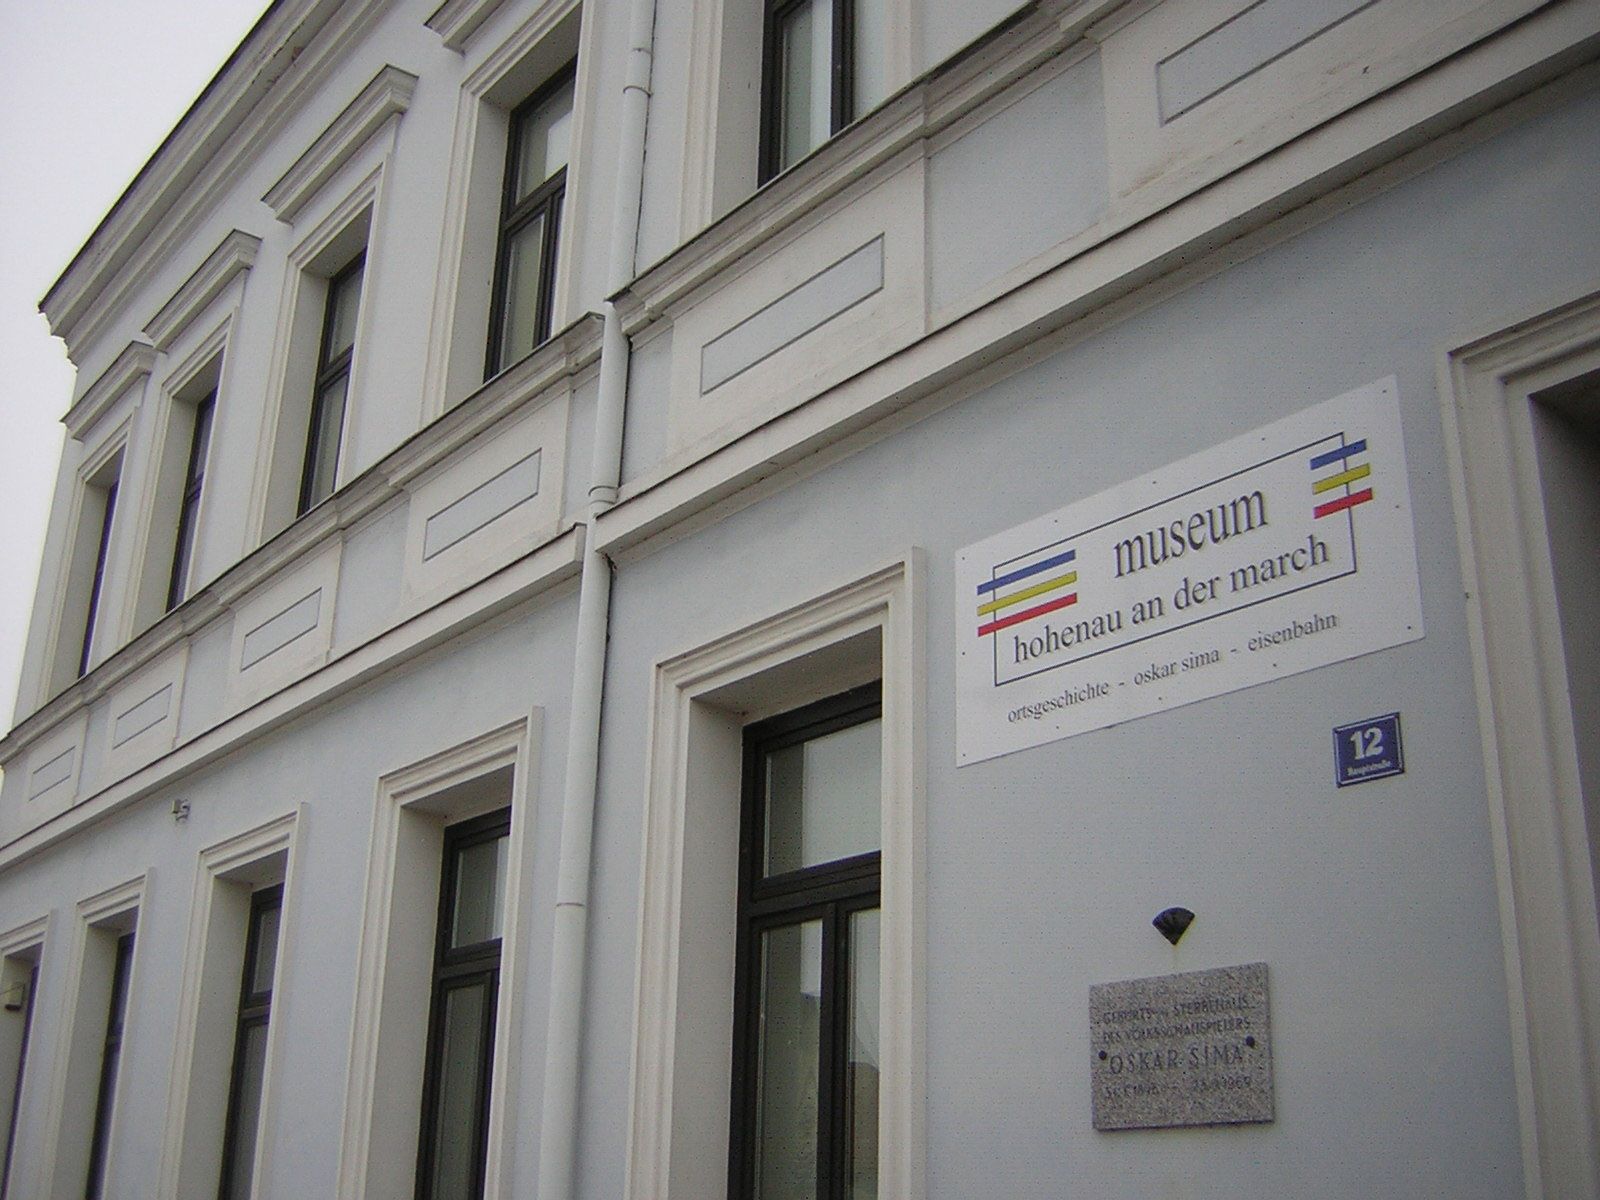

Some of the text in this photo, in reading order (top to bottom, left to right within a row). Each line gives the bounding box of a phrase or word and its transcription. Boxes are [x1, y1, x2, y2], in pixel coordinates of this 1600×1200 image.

[1113, 490, 1269, 579] museum
[1013, 534, 1330, 664] hohenau an der march
[1007, 681, 1110, 724] ortsgeschichte
[1134, 660, 1178, 686] oskar
[1181, 650, 1220, 673] sima
[1247, 613, 1338, 652] eisenbahn
[1349, 727, 1384, 760] 12
[1110, 1043, 1244, 1075] OSKAR SIMA
